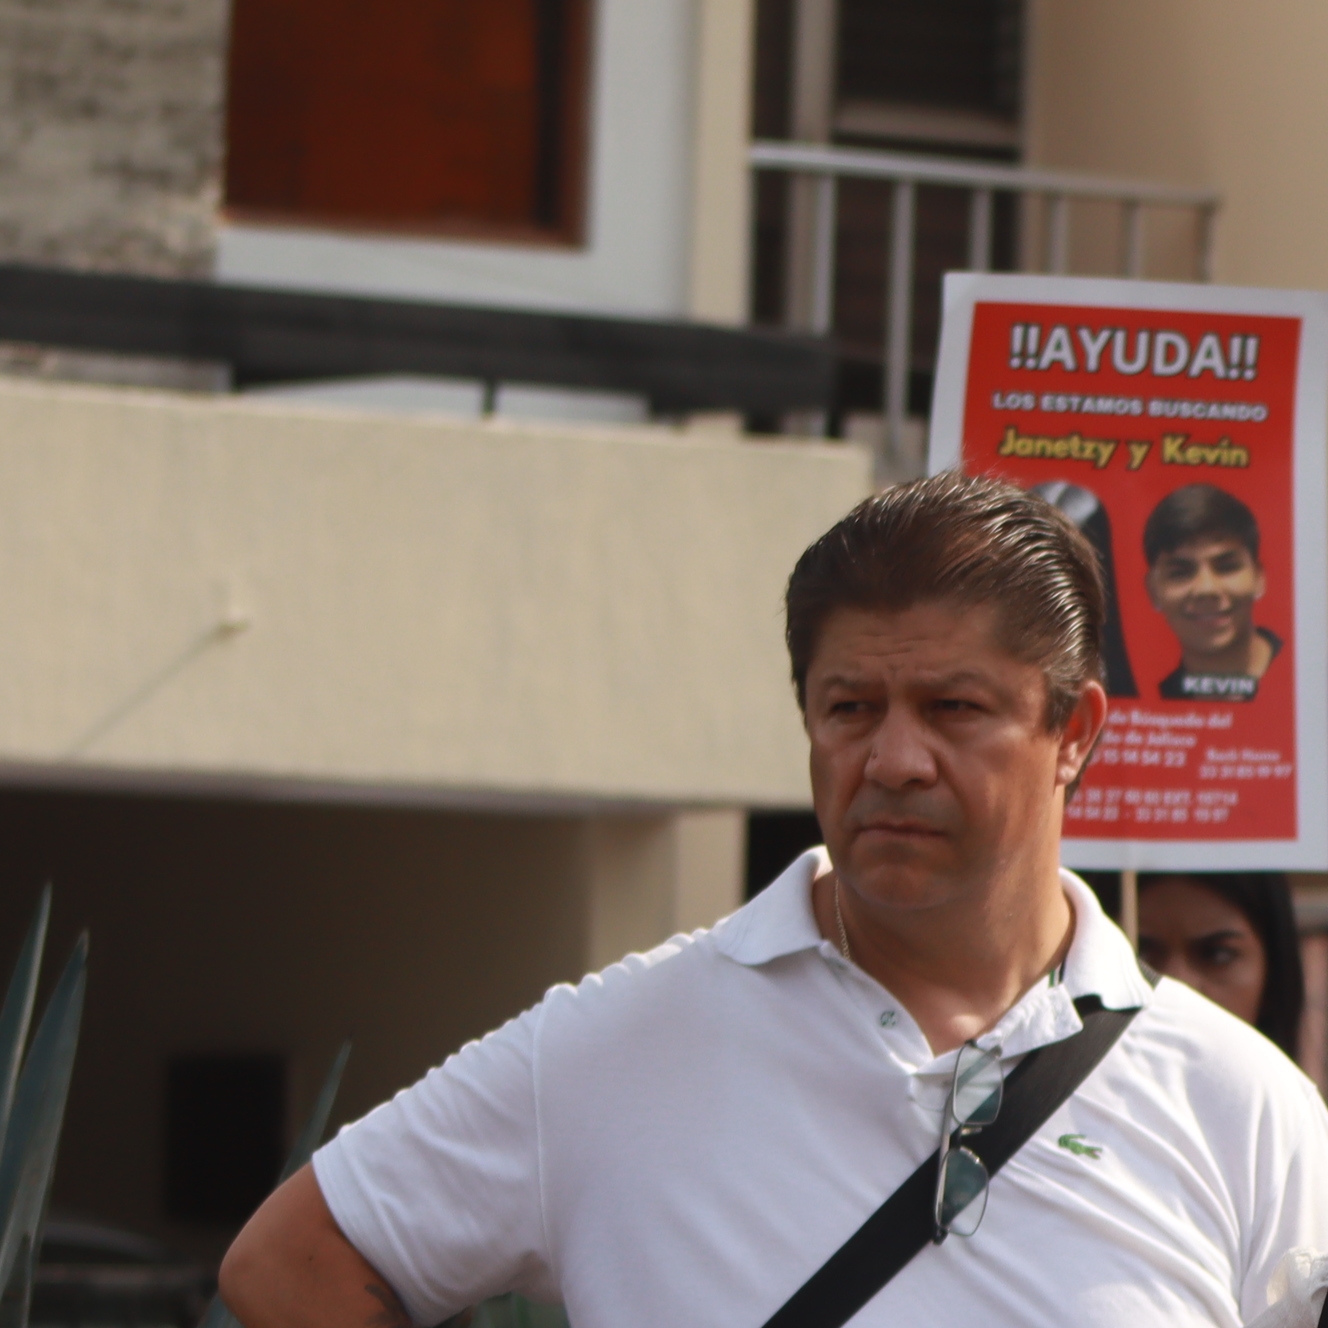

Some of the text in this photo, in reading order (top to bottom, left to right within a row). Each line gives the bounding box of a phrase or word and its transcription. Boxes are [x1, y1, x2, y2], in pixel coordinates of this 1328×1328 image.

[1009, 323, 1260, 381] !!AYUDA!!
[992, 391, 1269, 423] LOS ESTAMOS BUSCANDO
[1000, 426, 1250, 470] Janetzy y Kevin
[1182, 675, 1256, 694] KEVIN
